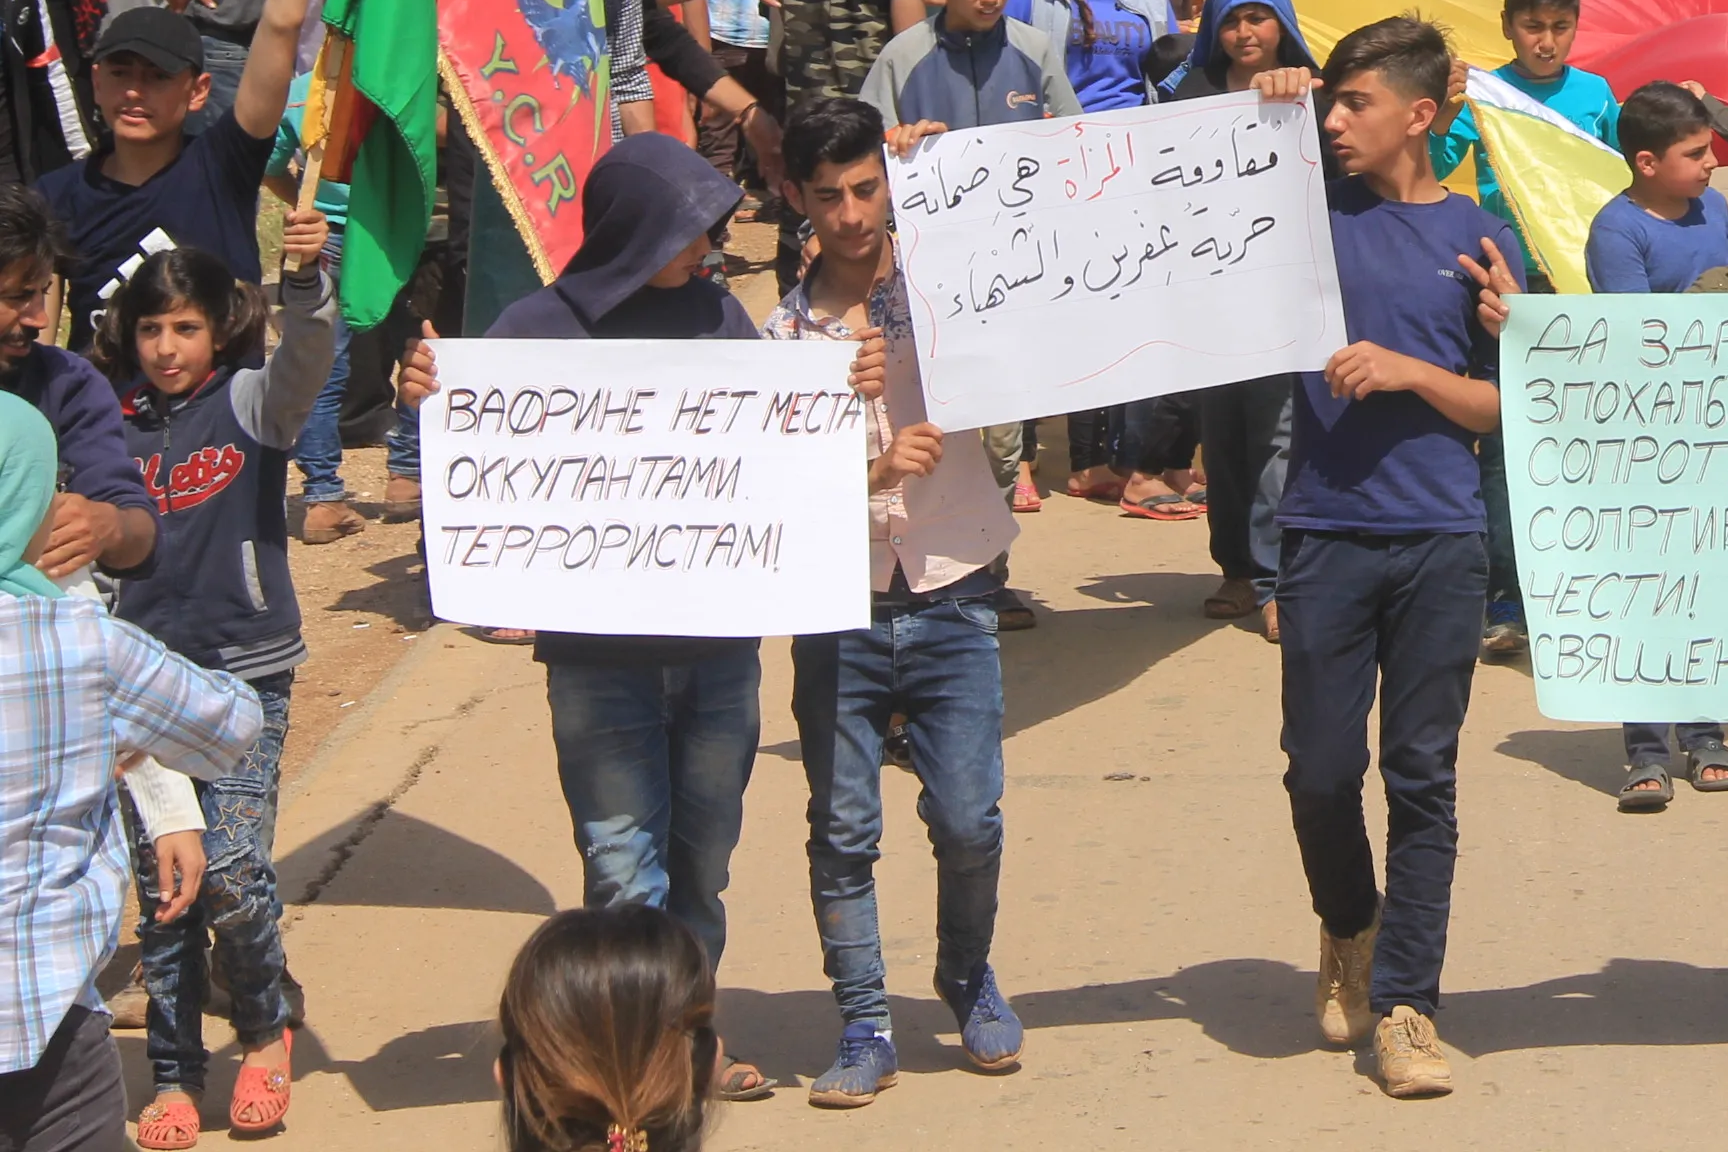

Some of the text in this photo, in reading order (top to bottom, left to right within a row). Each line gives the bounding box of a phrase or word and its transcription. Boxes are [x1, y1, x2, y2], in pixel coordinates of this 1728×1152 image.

[1525, 312, 1609, 366] ДА
[669, 388, 761, 433] НЕТ
[763, 390, 862, 435] МЕСТА
[440, 519, 784, 573] ТЕРРОРИСТАМ!
[1526, 570, 1698, 622] ЧЕСТИ!
